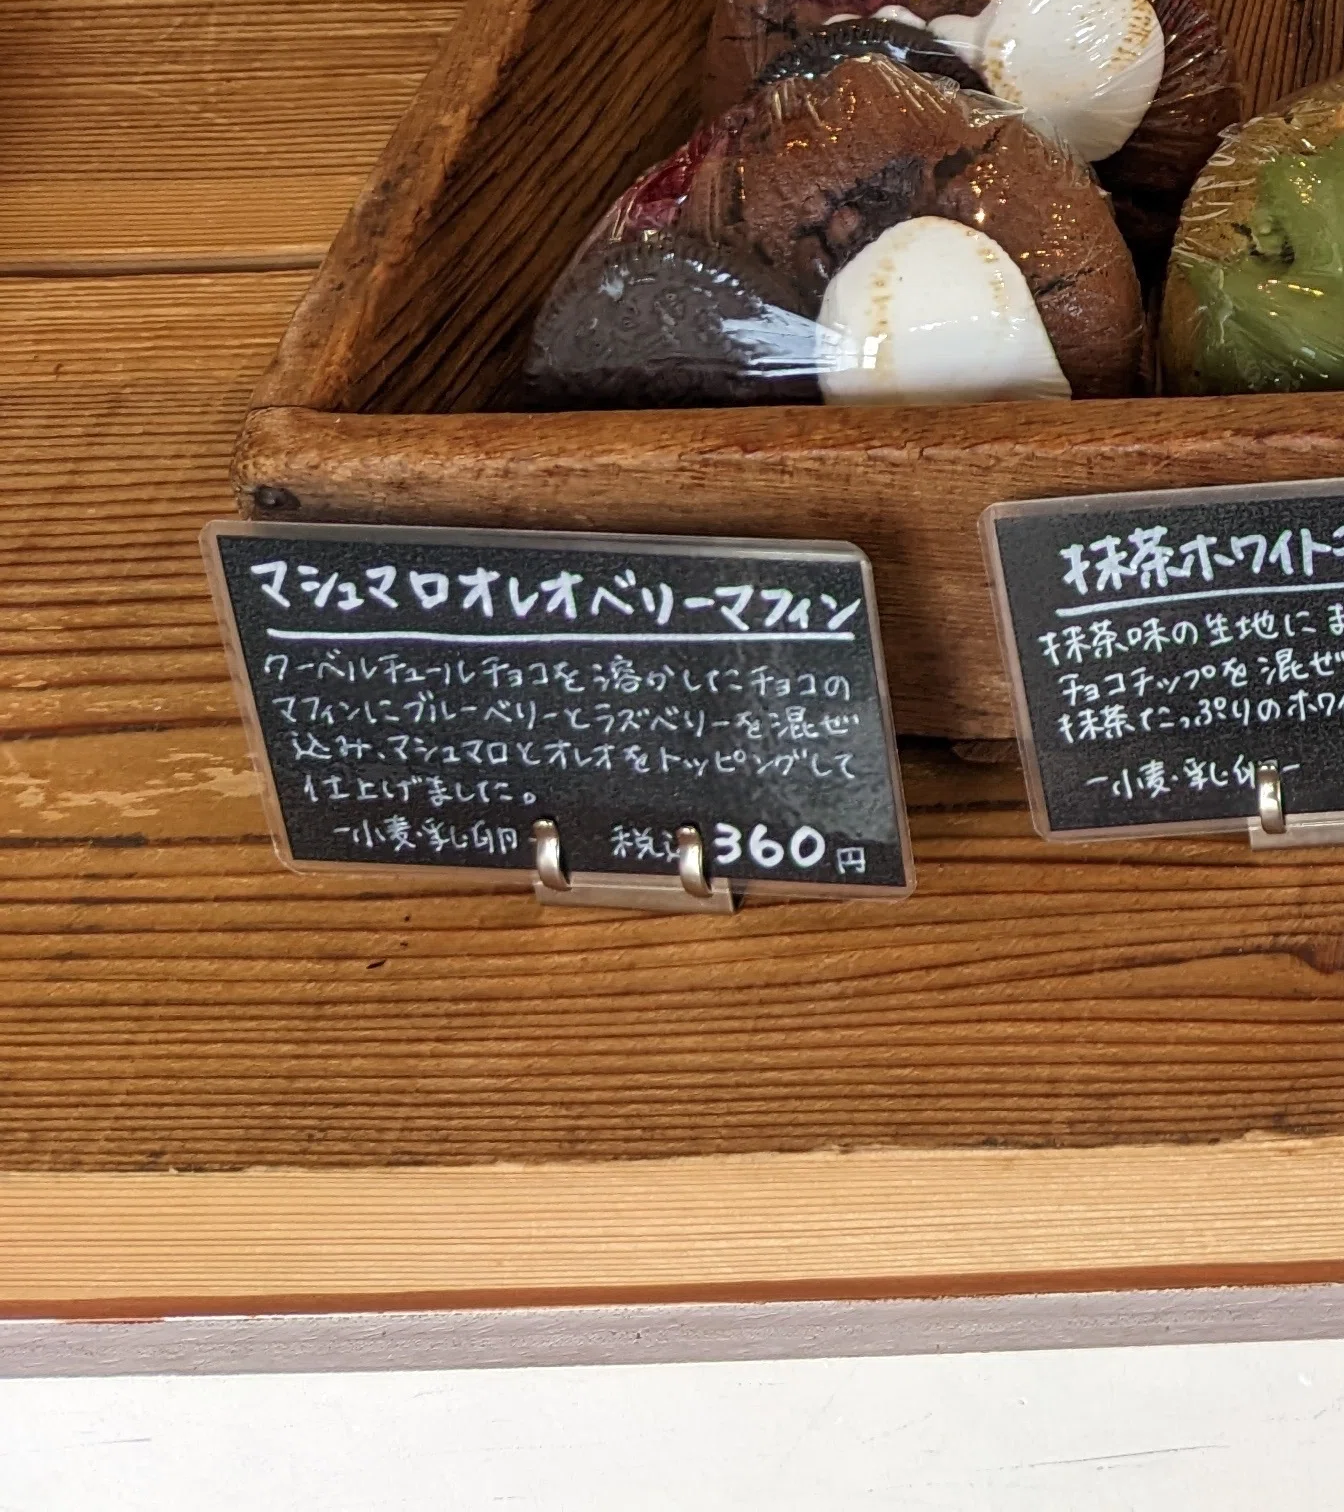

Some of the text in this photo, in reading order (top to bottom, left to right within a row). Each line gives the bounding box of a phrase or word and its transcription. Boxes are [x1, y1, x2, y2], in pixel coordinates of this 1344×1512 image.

[250, 560, 862, 631] マシュマロオレオベリーマフィン
[303, 777, 538, 807] 仕上げました。
